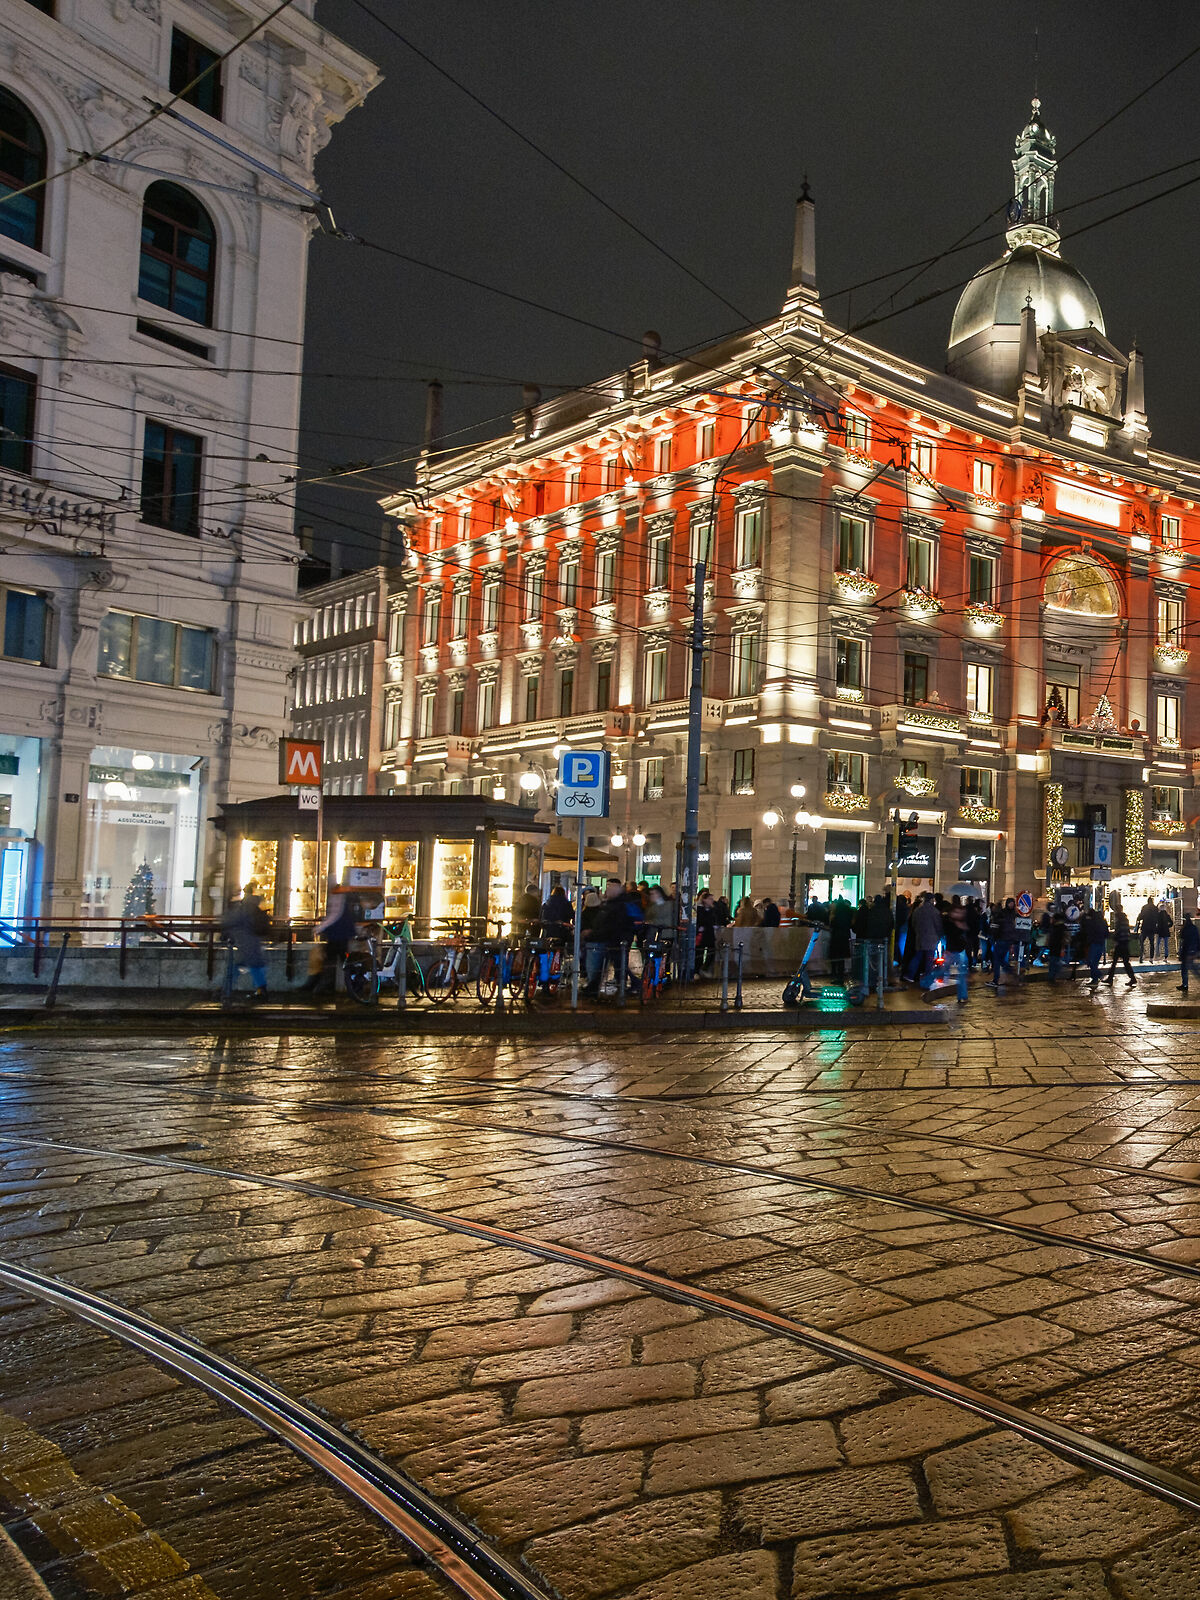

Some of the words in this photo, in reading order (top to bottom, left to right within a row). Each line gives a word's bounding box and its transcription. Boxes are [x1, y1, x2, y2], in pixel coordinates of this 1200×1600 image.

[288, 750, 319, 777] M
[572, 758, 593, 783] P
[302, 795, 318, 804] WC
